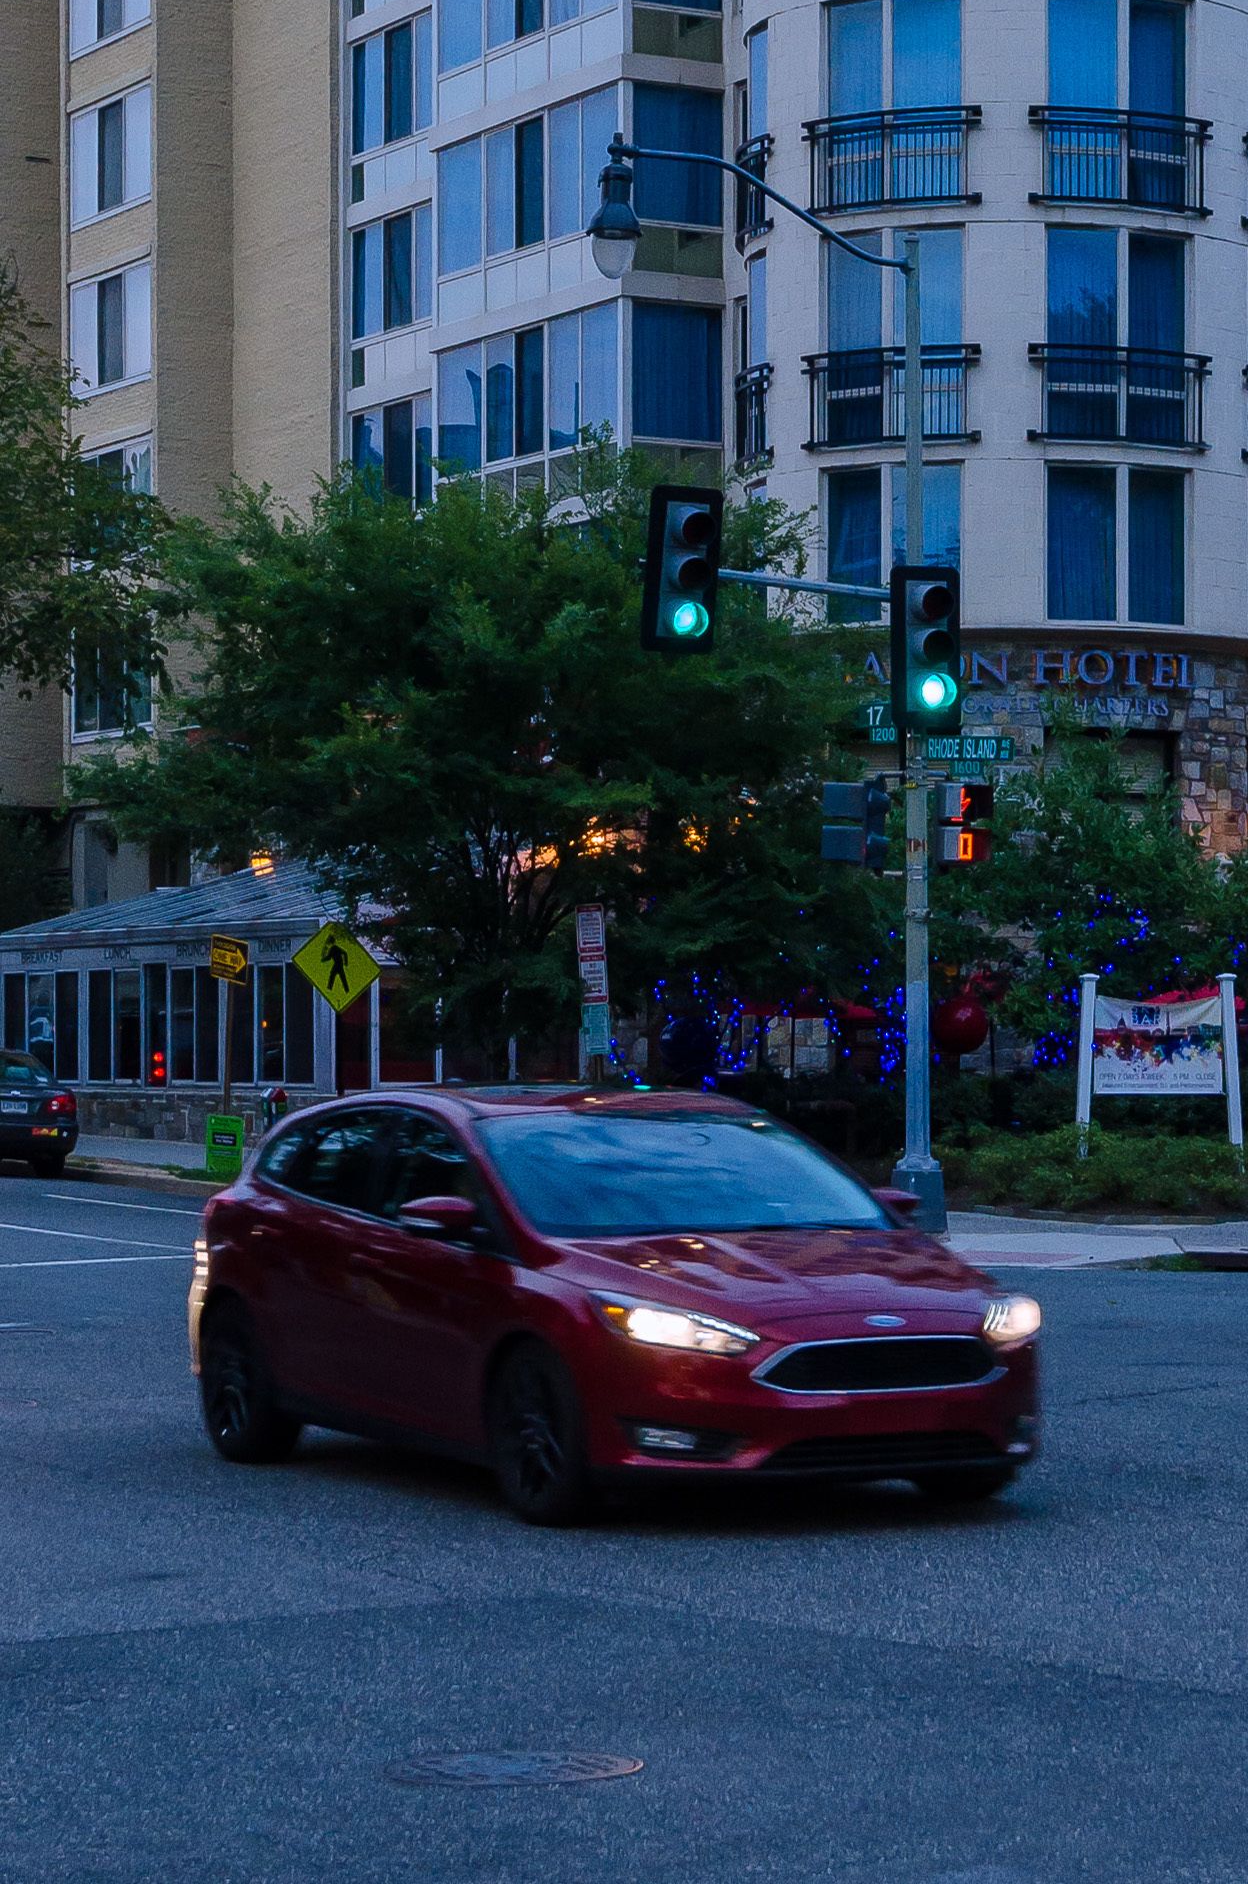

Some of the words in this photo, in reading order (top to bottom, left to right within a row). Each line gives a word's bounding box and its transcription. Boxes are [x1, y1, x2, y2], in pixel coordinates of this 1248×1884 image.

[1031, 649, 1194, 688] HOTEL
[866, 705, 884, 726] 17
[872, 727, 896, 742] 1200
[928, 737, 960, 759] RHODE
[963, 737, 997, 759] ISLAND
[953, 761, 981, 775] 1600
[258, 938, 293, 953] DINNER
[21, 950, 63, 964] BREAKFAST
[104, 947, 131, 960] LUNCH
